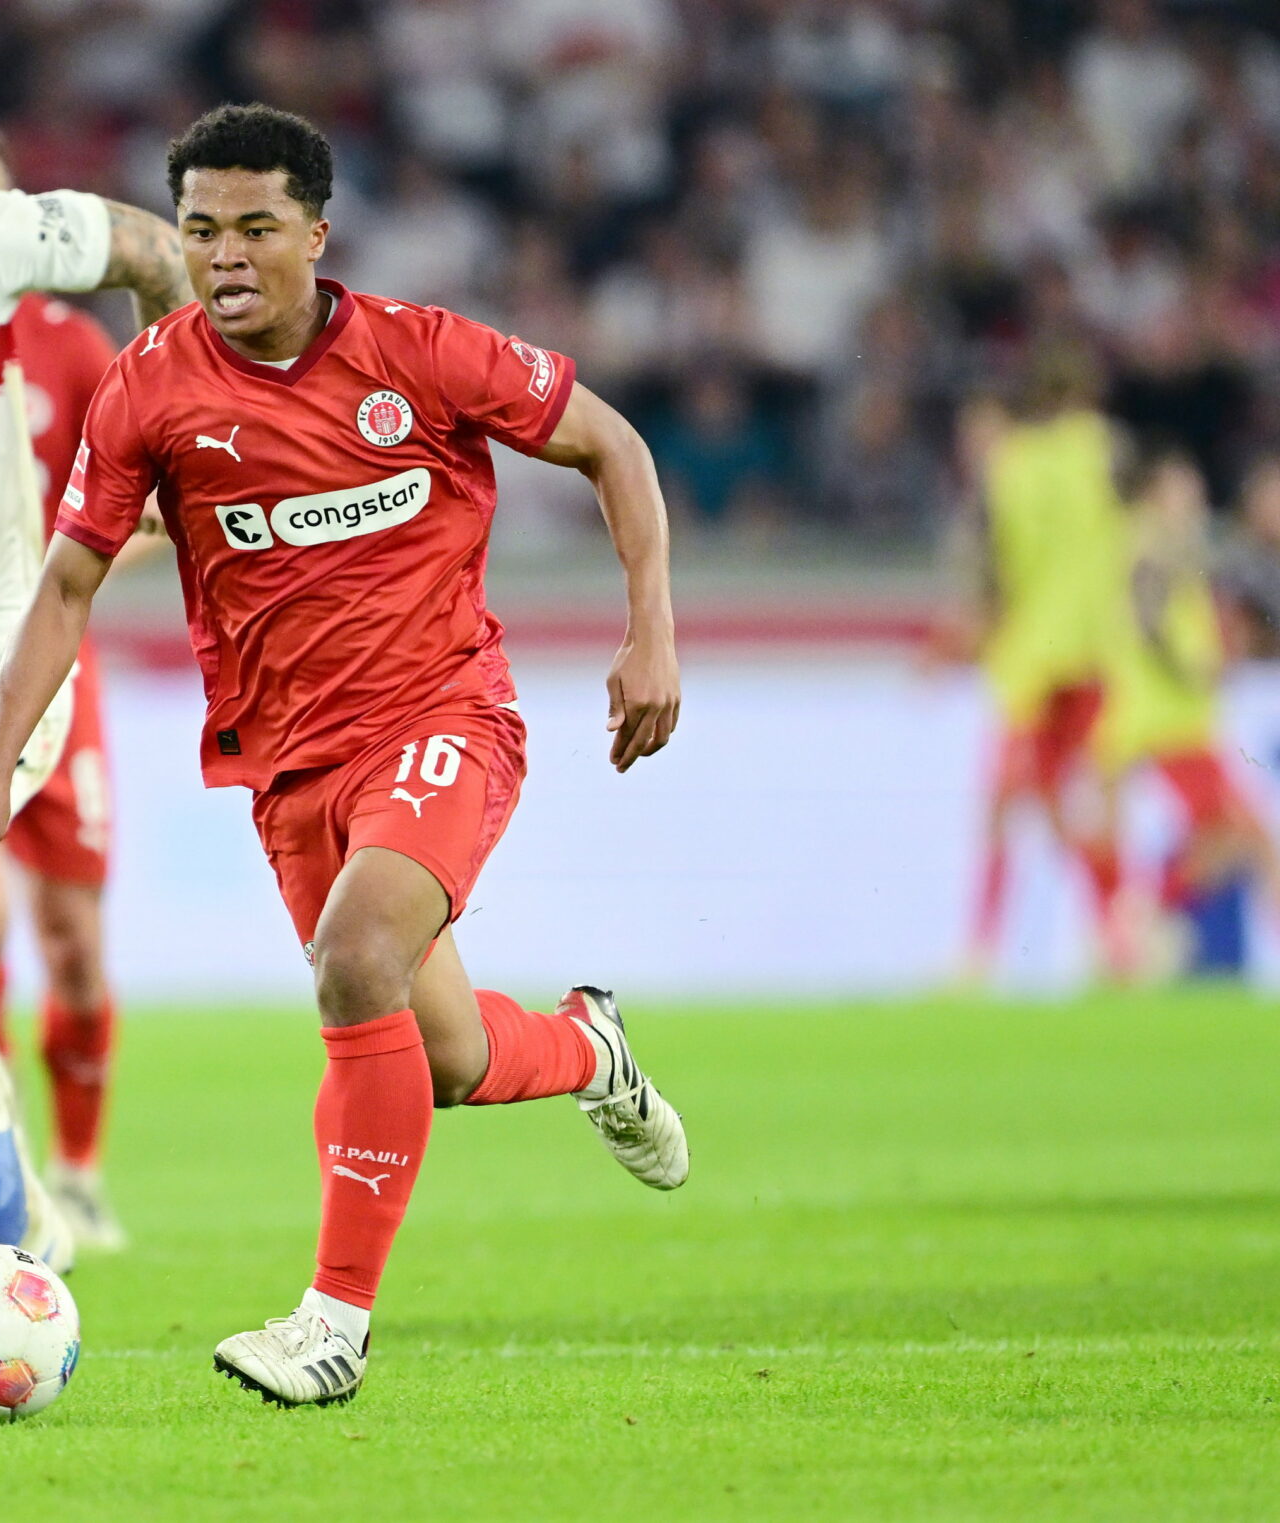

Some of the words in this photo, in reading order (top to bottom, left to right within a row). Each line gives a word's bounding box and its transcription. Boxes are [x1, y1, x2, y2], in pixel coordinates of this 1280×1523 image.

[381, 392, 410, 414] PAULI
[378, 434, 401, 445] 1910
[289, 482, 419, 529] congstar
[394, 734, 467, 787] 16
[328, 1144, 346, 1158] ST.
[347, 1147, 409, 1167] PAULI
